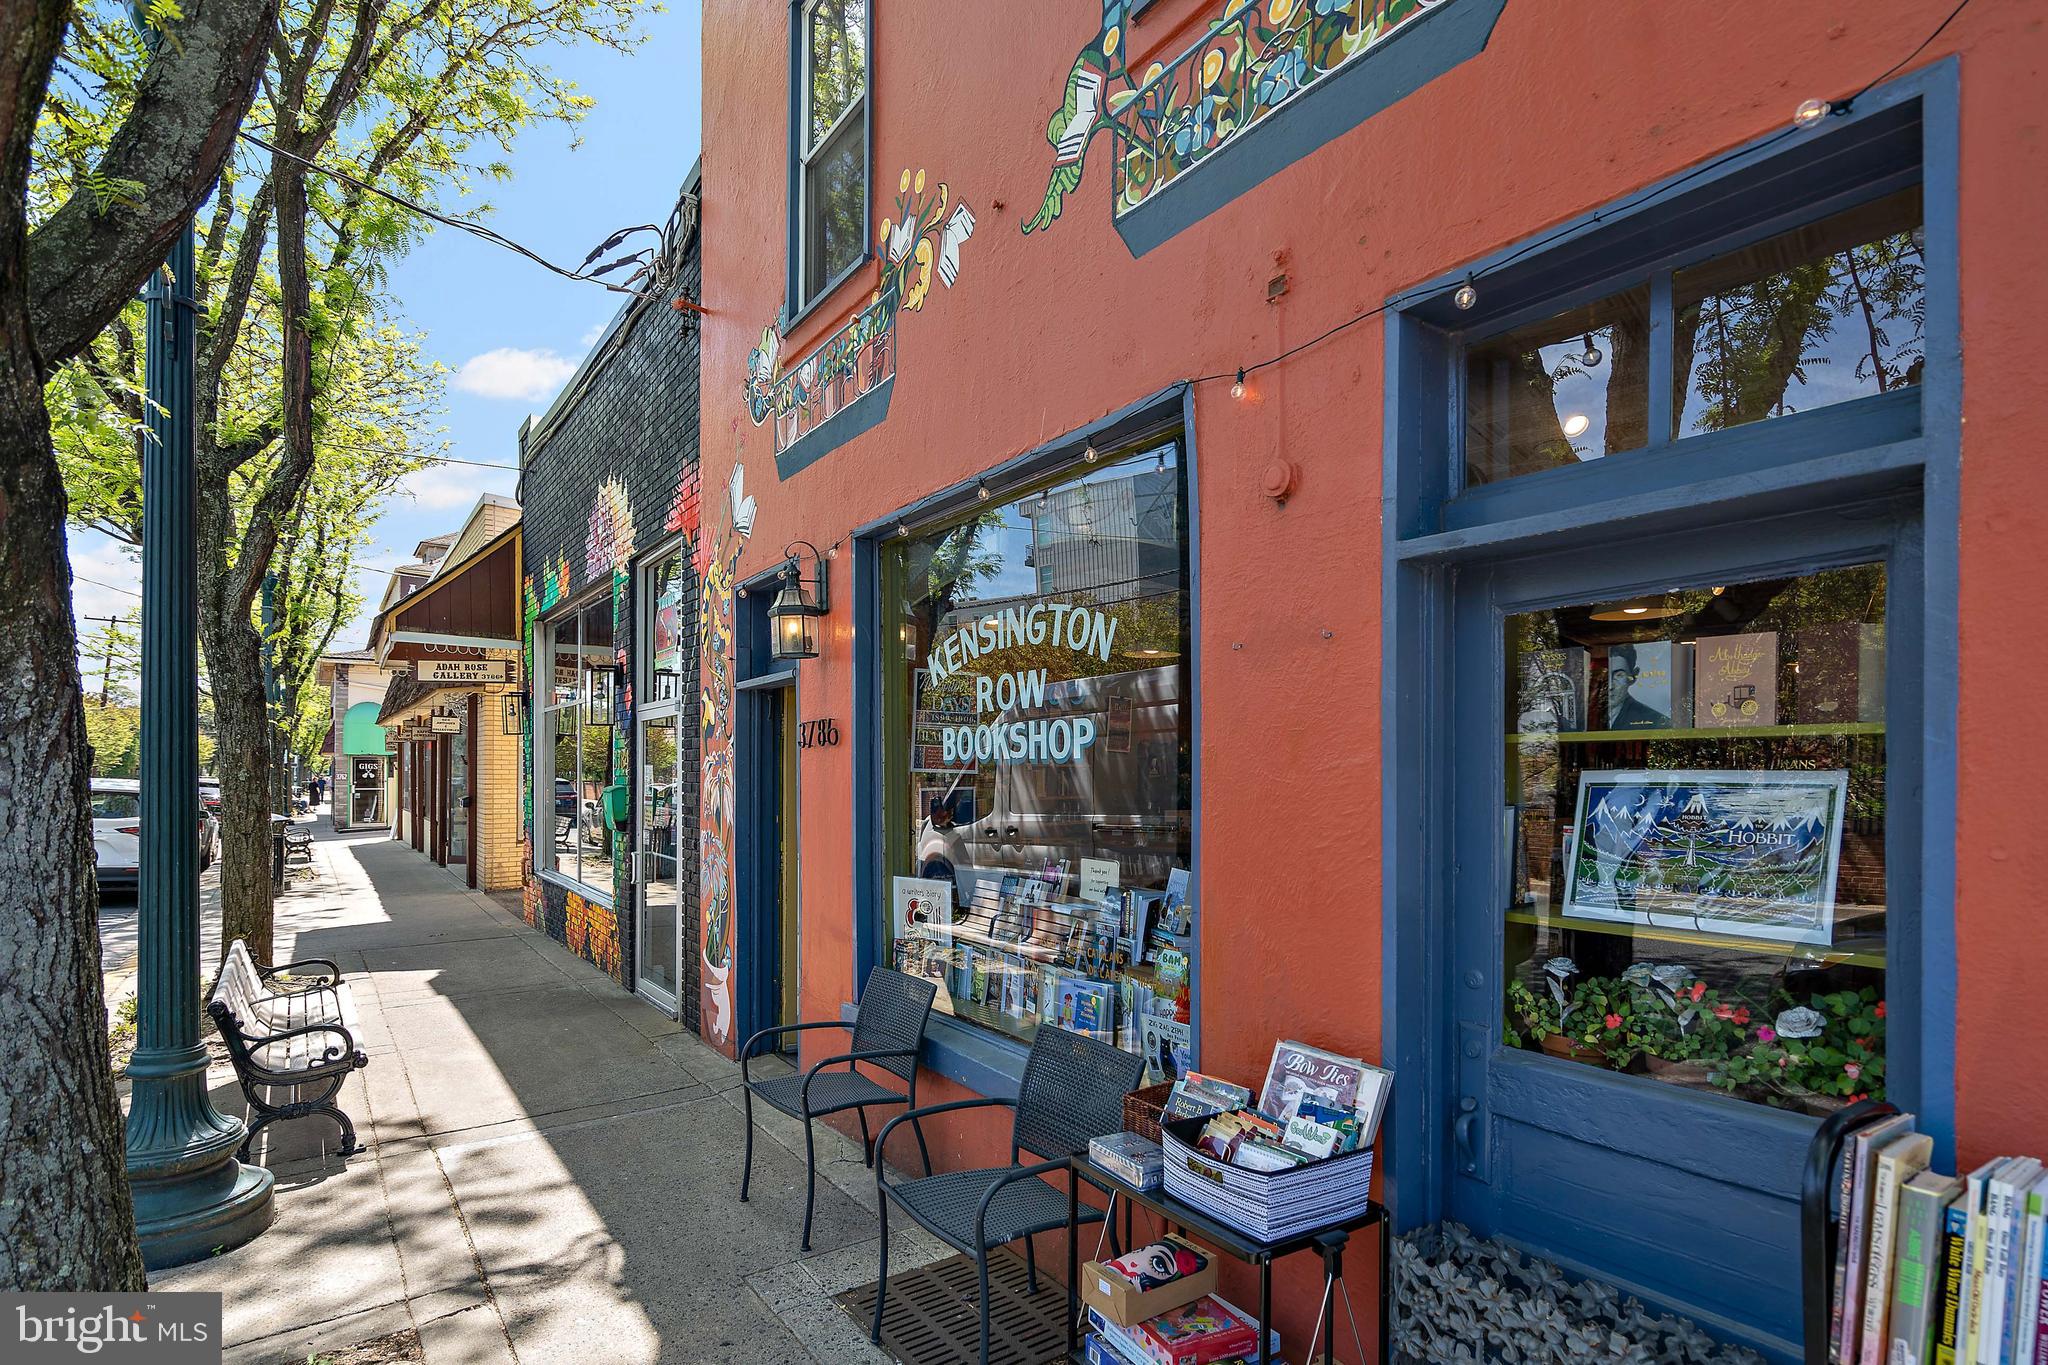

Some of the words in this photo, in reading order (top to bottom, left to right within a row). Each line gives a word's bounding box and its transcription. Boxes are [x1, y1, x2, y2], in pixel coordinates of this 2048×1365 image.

[927, 603, 1118, 688] KENSINGTON
[433, 672, 479, 680] GALLERY
[976, 668, 1047, 713] ROW
[798, 718, 839, 748] 3786
[943, 718, 1096, 765] BOOKSHOP
[1728, 830, 1796, 845] HOBBIT
[1284, 1054, 1319, 1075] Bow
[1319, 1064, 1351, 1087] Ties
[1175, 1097, 1196, 1112] Robert
[1949, 1236, 1966, 1267] White
[1946, 1267, 1961, 1294] Wine
[2040, 1280, 2048, 1325] POWER
[1942, 1299, 1959, 1347] Dummies
